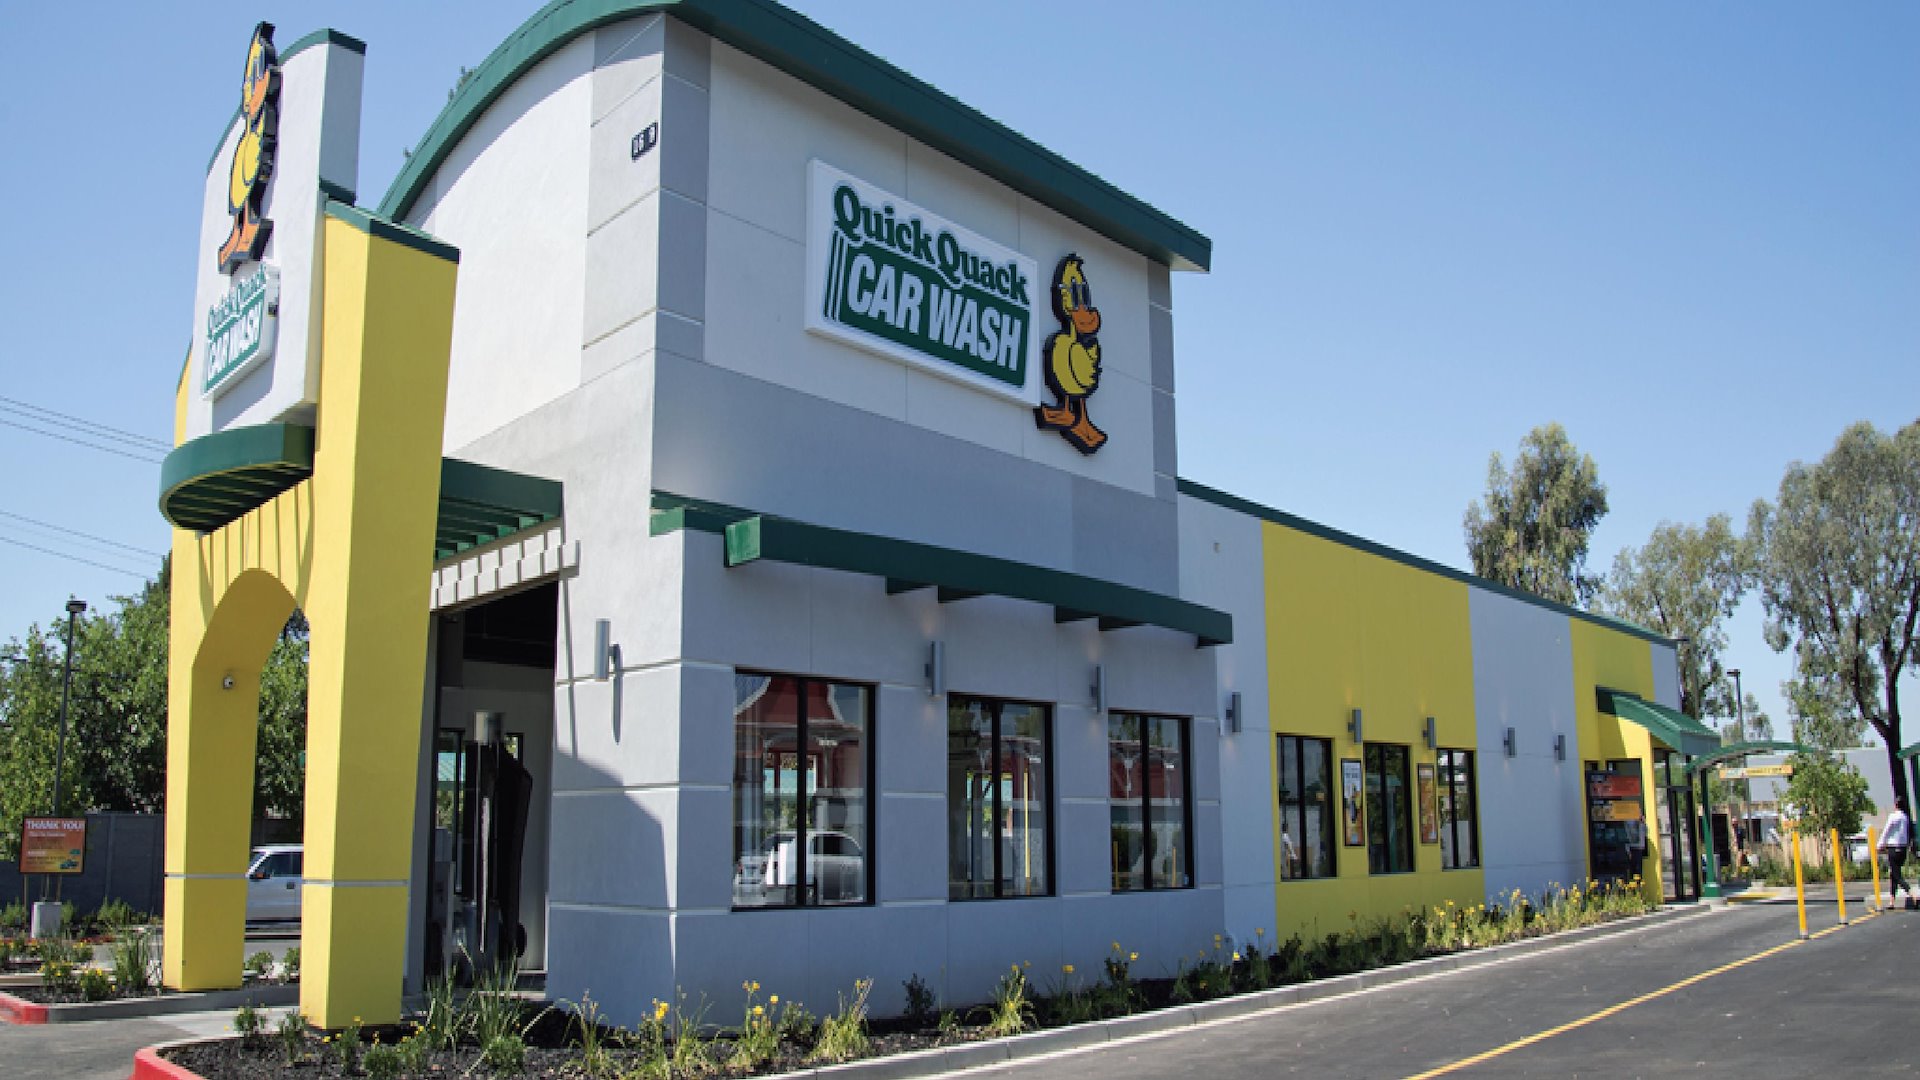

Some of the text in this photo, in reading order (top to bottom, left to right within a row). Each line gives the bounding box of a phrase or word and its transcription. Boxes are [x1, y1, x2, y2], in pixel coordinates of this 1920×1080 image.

[833, 185, 1030, 305] Quick Quack
[229, 300, 262, 363] WASH
[847, 253, 1022, 372] CAR WASH
